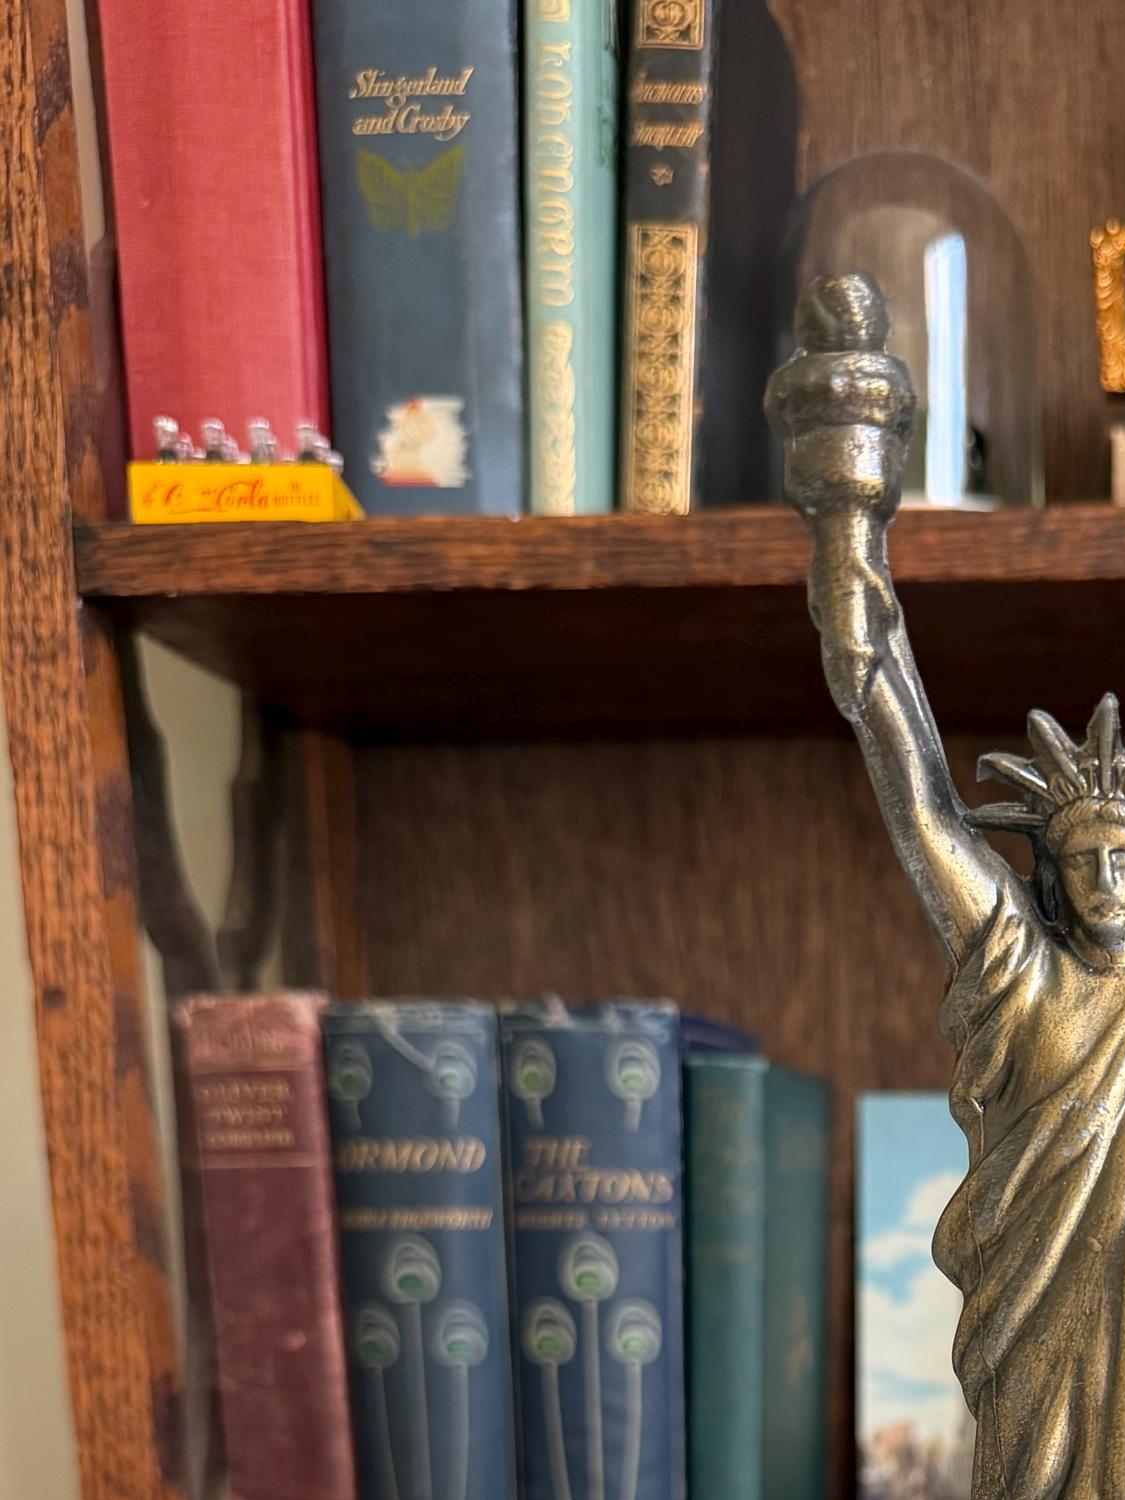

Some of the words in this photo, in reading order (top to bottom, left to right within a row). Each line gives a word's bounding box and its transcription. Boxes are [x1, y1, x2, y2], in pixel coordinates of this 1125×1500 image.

[349, 66, 475, 109] Slingerland
[352, 108, 399, 135] and
[396, 103, 470, 142] Crosby
[335, 1137, 487, 1174] ORMOND
[526, 1135, 592, 1167] THE
